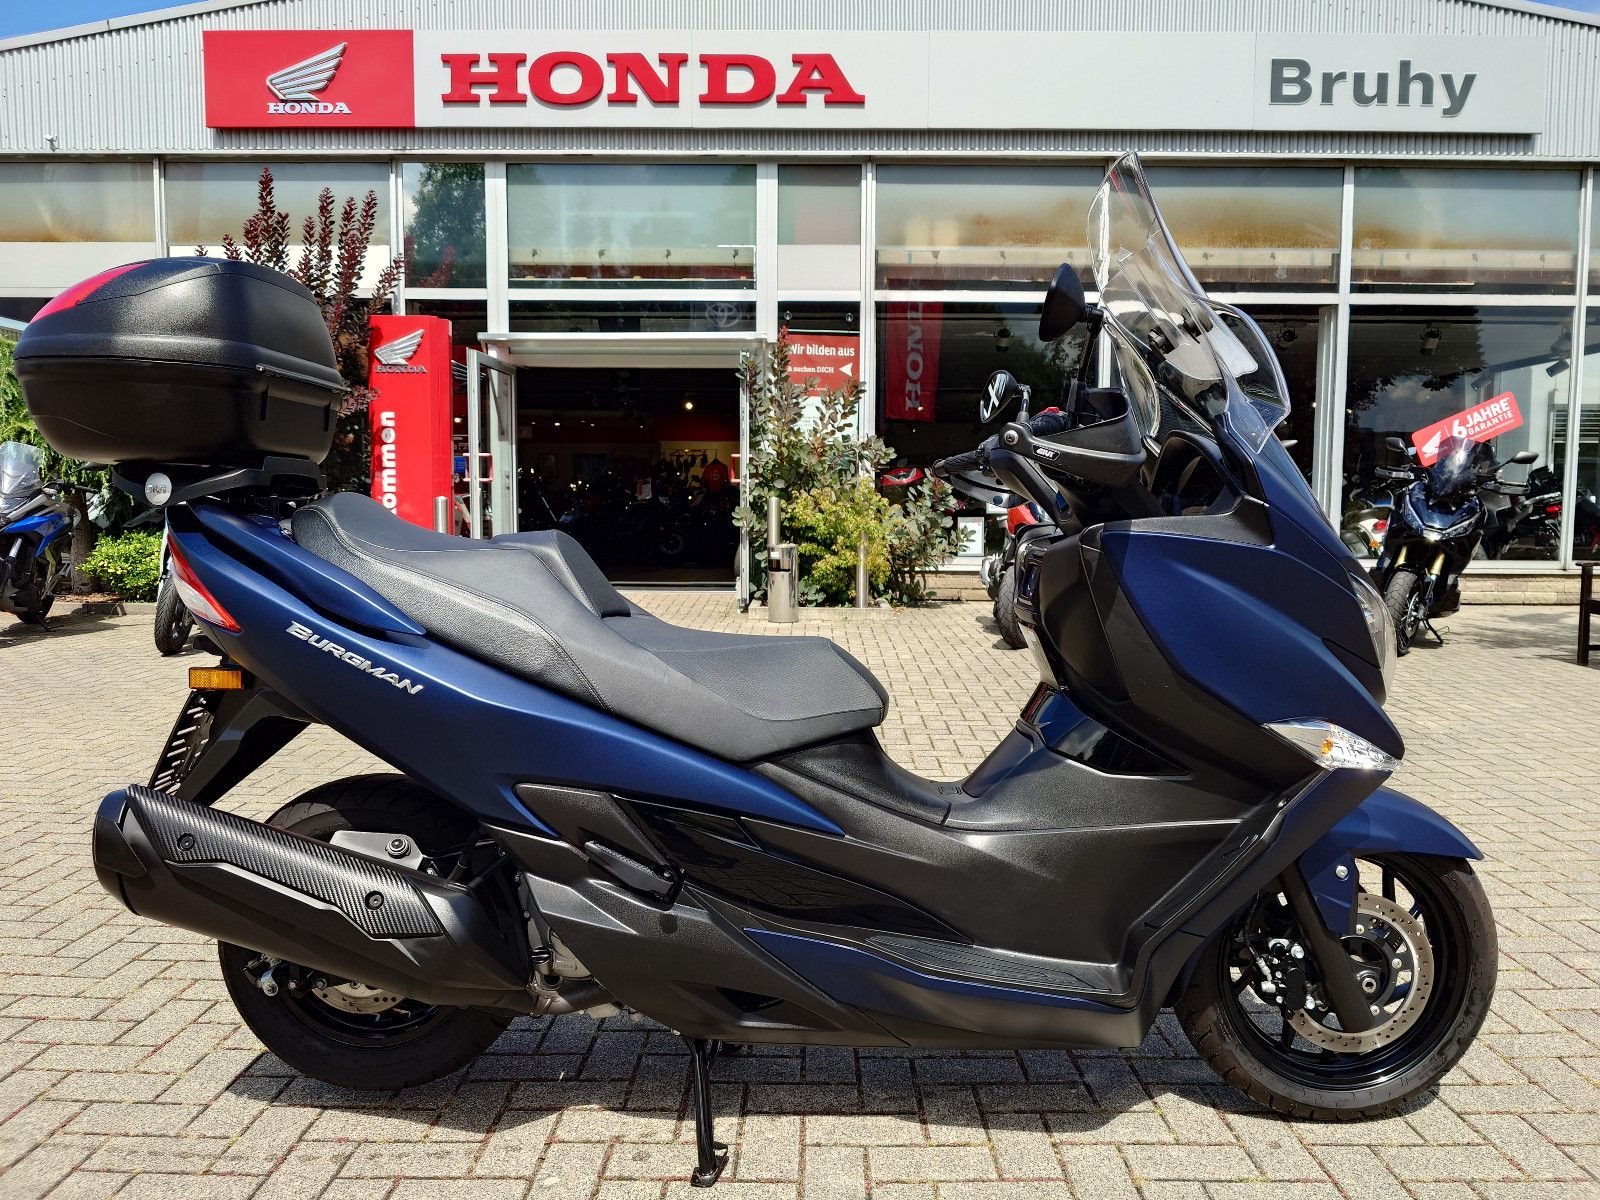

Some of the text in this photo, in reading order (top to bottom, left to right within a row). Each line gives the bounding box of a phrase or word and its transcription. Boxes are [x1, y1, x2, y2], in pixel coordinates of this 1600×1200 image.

[441, 51, 866, 107] HONDA
[1269, 58, 1478, 118] Bruhy
[267, 102, 352, 114] HONDA
[806, 344, 836, 356] bilden
[837, 346, 855, 357] aus
[375, 364, 428, 373] HONDA
[816, 366, 834, 374] DICH
[1452, 419, 1468, 438] 6
[1466, 397, 1511, 427] JAHRE
[1468, 410, 1514, 436] GARANTIE
[286, 620, 424, 695] BURGMAN
